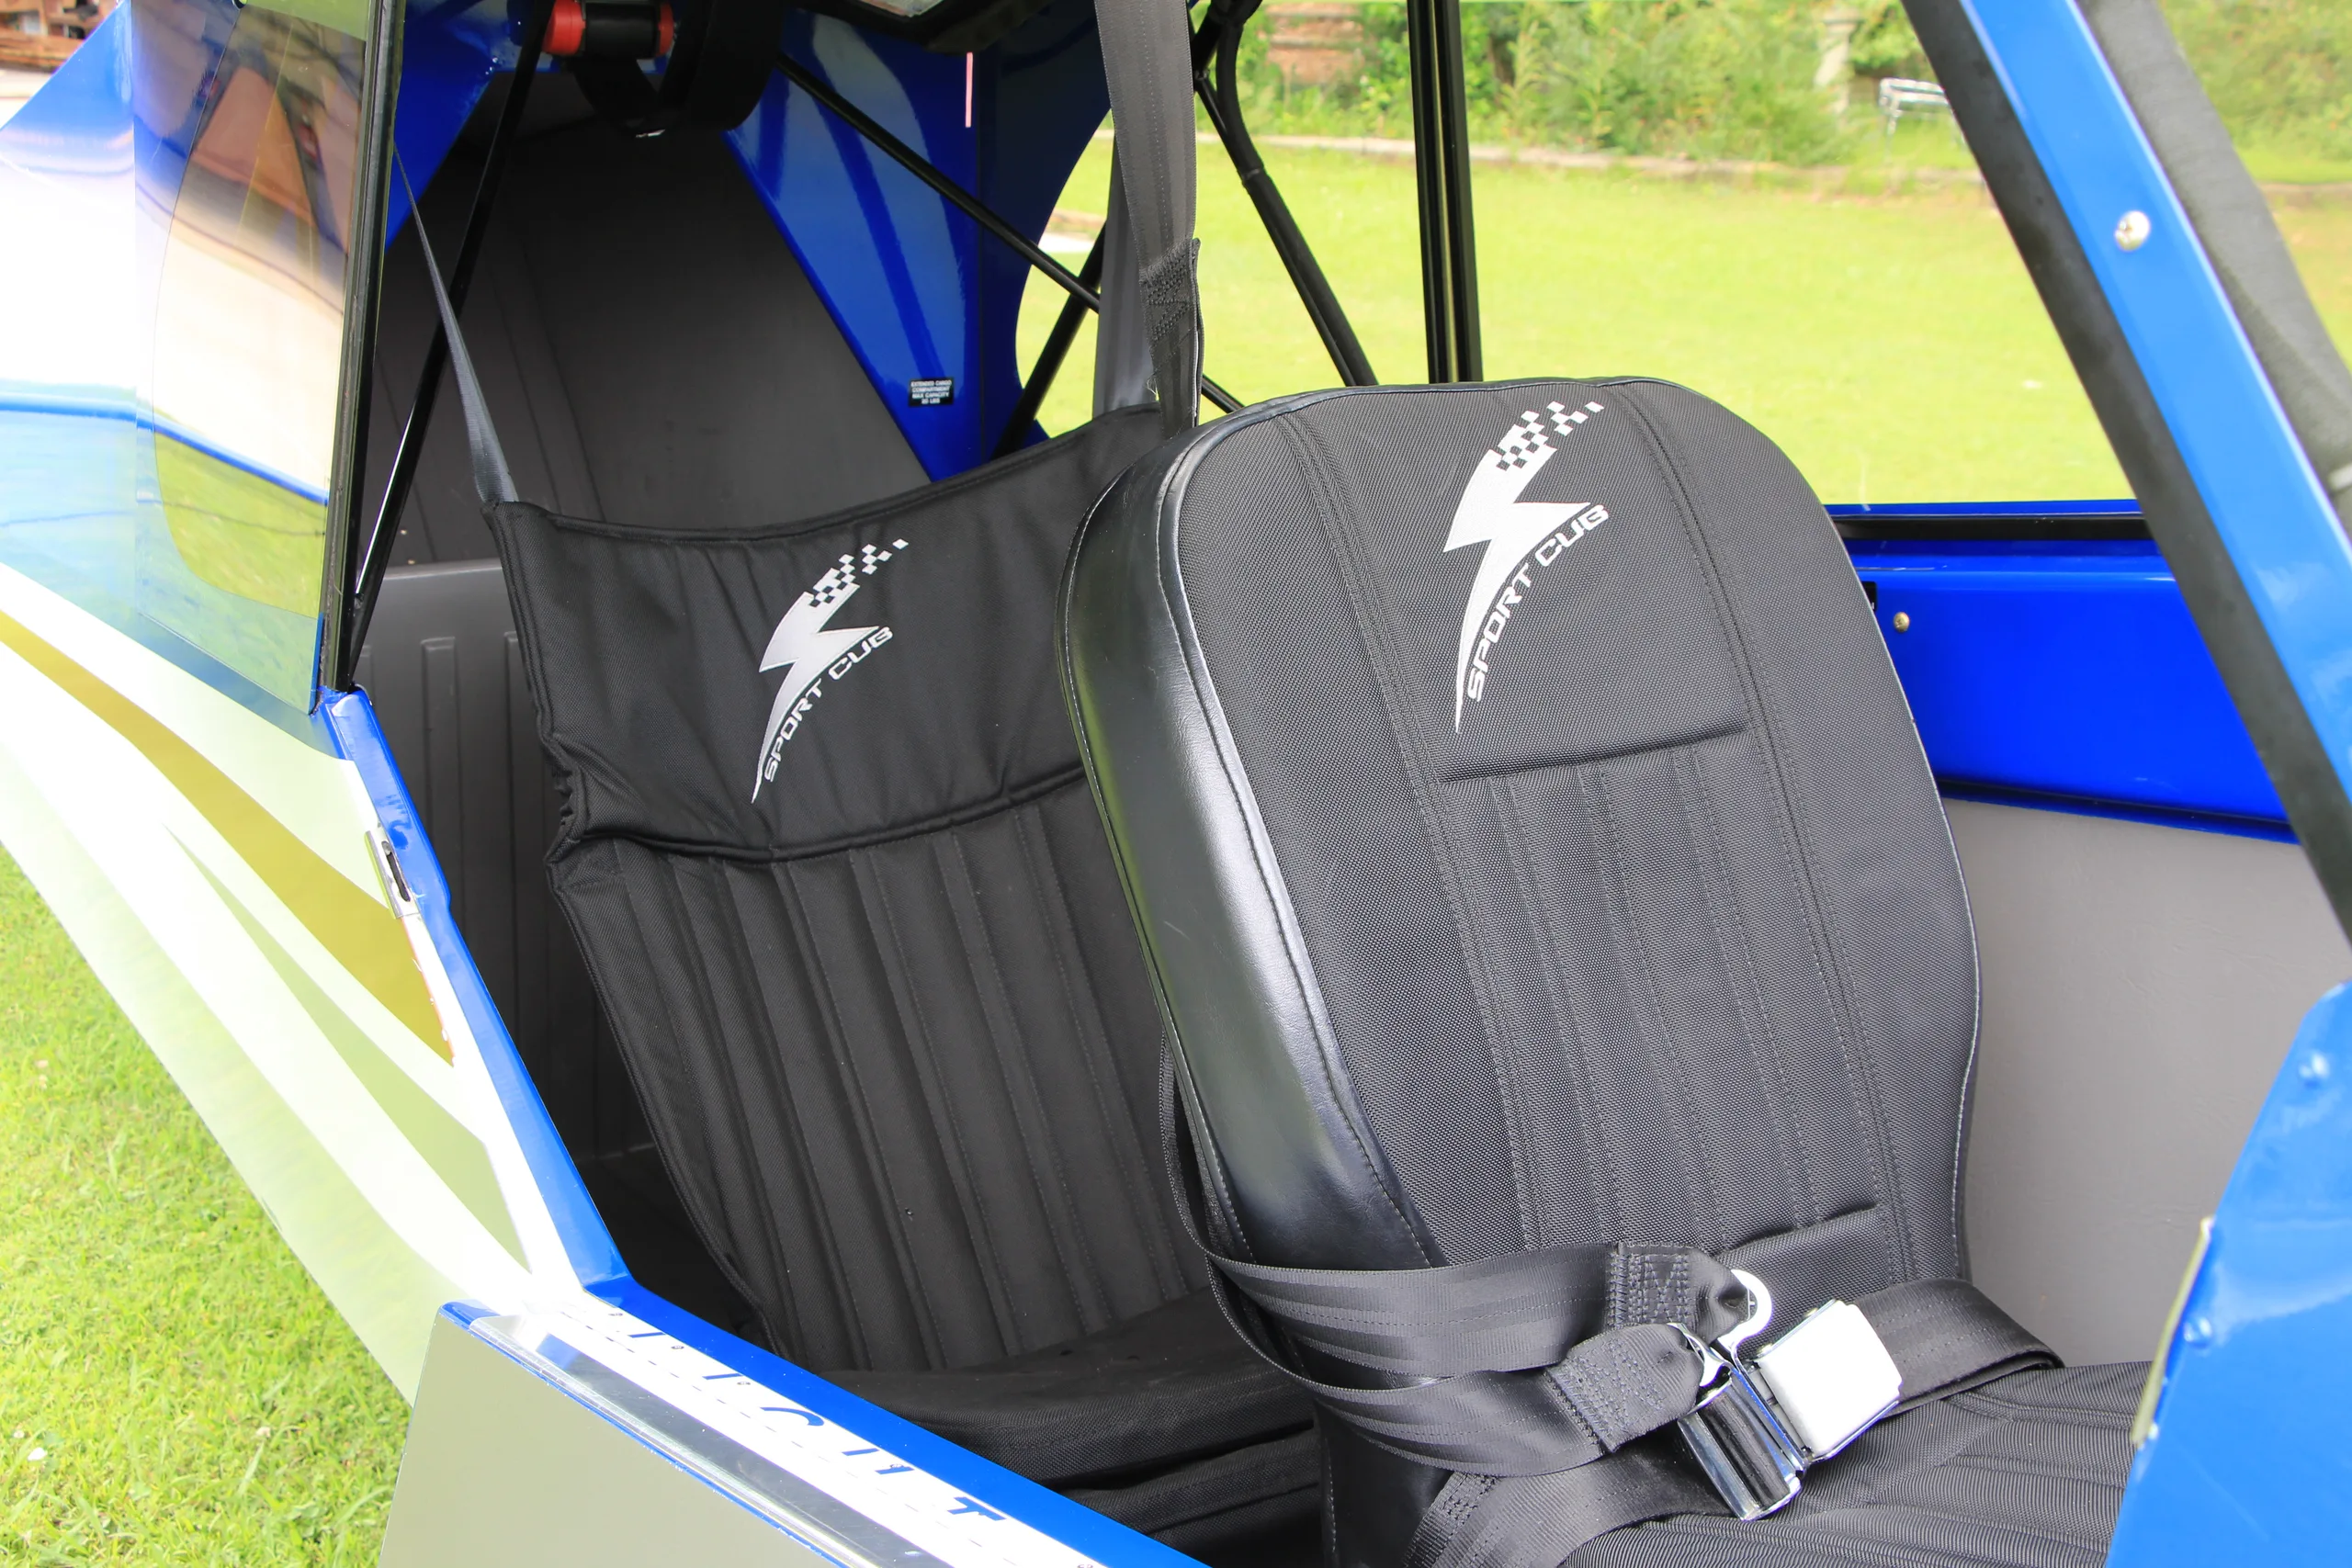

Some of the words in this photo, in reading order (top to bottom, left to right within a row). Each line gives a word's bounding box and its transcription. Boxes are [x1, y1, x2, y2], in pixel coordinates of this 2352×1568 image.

[1467, 562, 1532, 702] SPORT
[1535, 504, 1610, 567] CUB
[763, 679, 822, 782] SPORT
[828, 626, 893, 680] CUB
